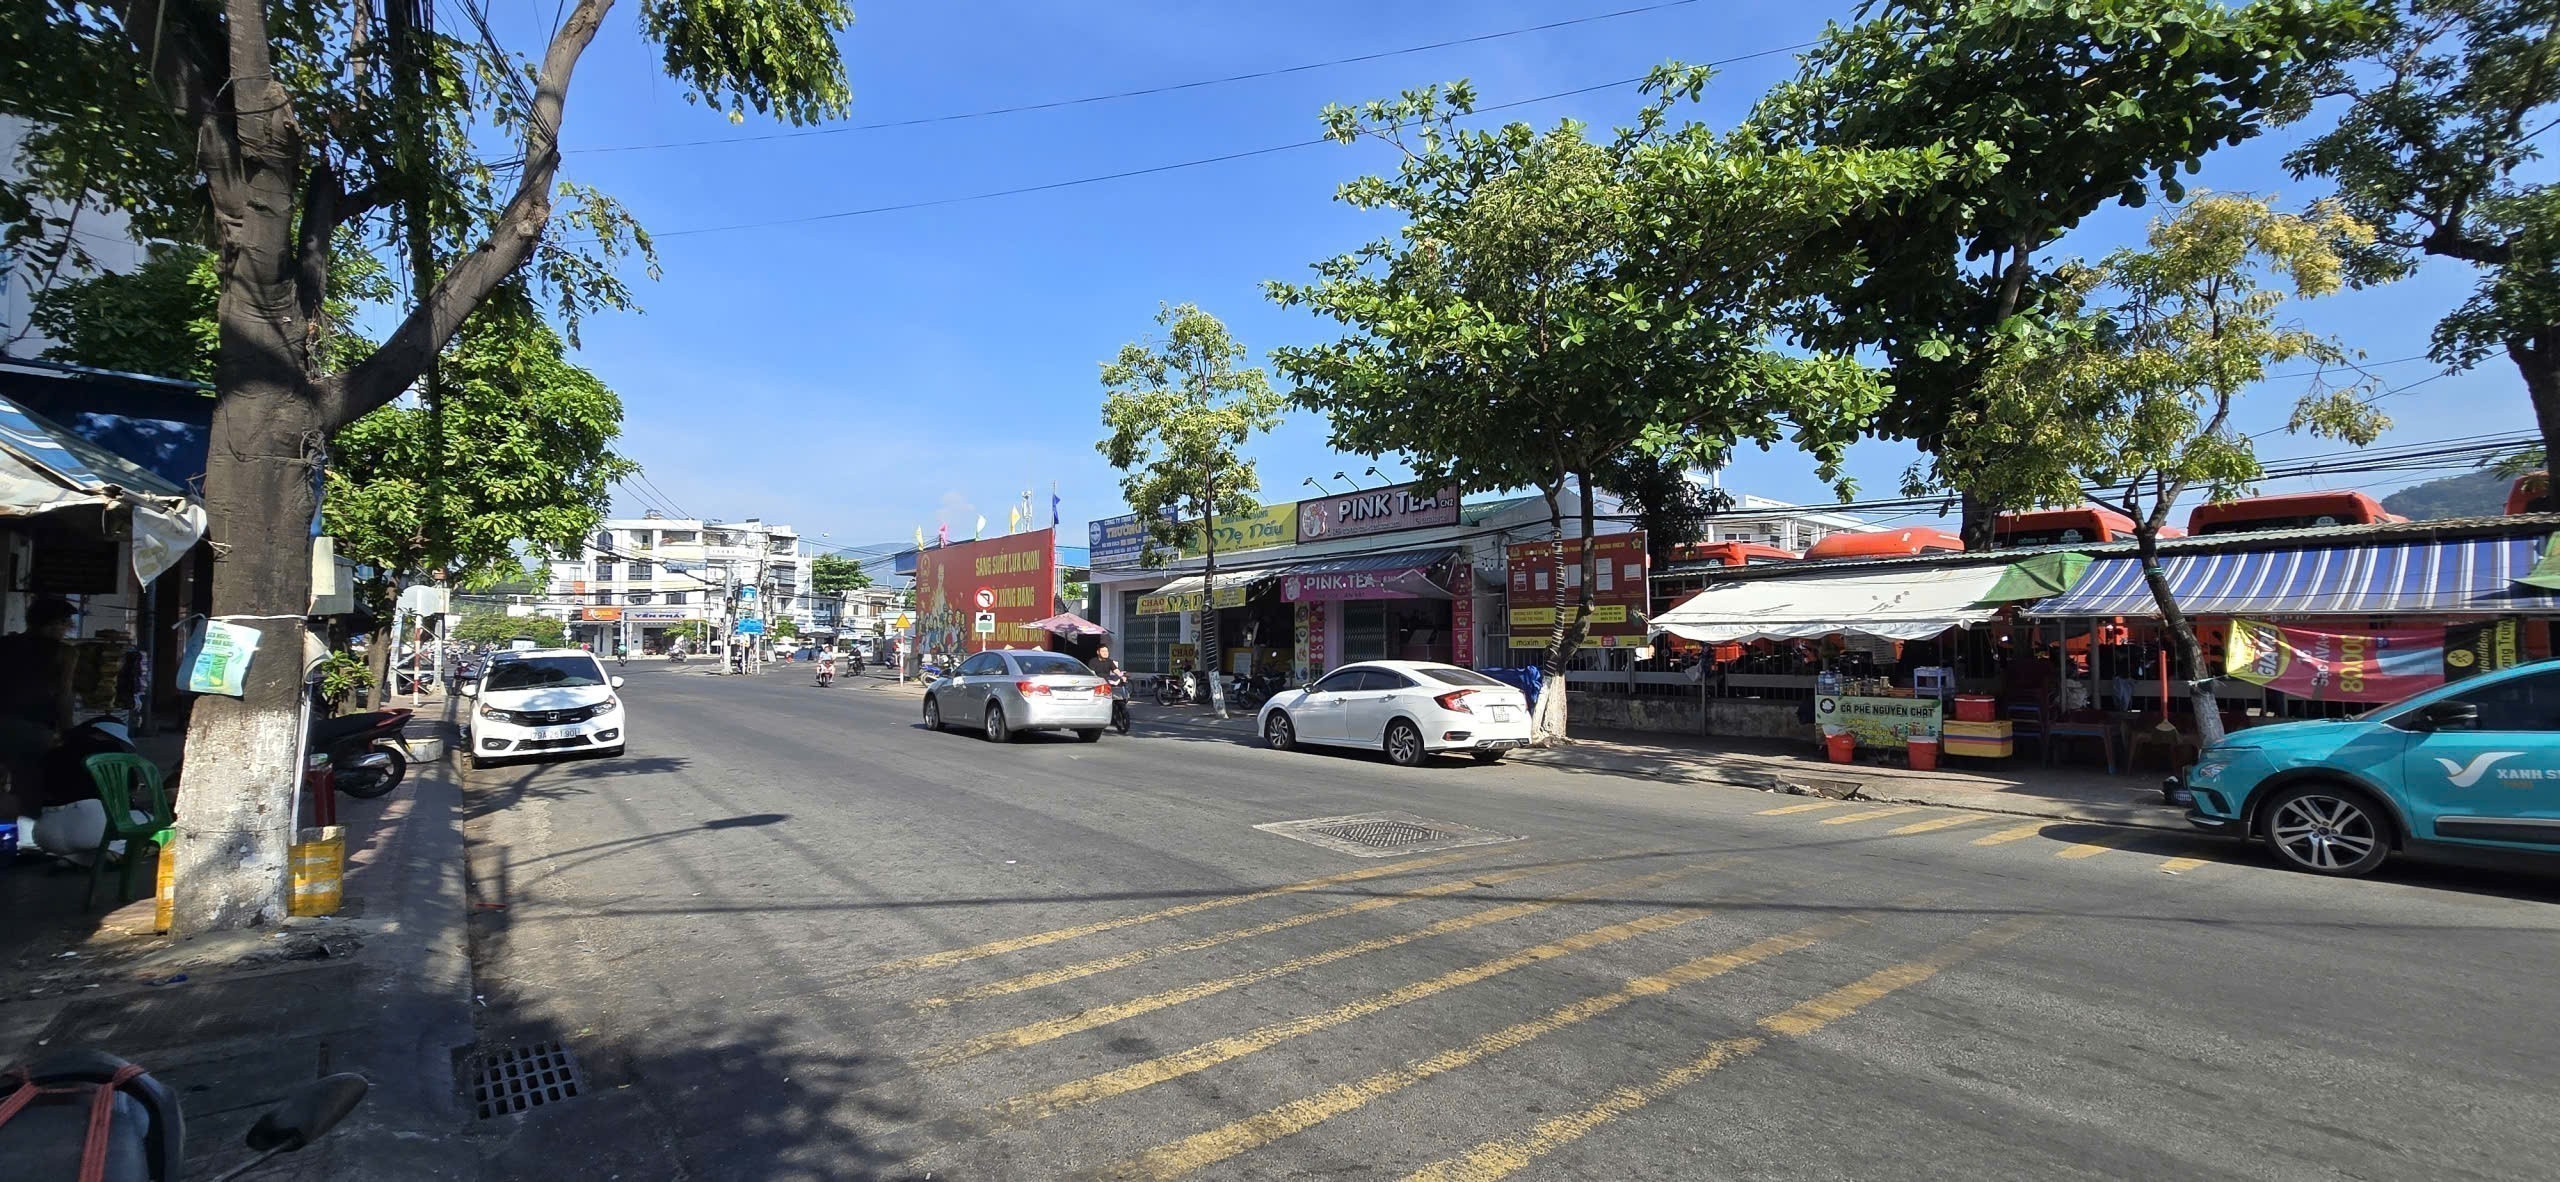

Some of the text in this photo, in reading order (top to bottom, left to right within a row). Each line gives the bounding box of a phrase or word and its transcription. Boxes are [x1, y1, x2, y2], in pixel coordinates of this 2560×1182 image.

[1338, 492, 1392, 523] PINK
[976, 554, 991, 576] SÁNG
[992, 548, 1008, 574] SUỐT
[1023, 550, 1040, 574] CHỌN
[1306, 576, 1343, 591] PINK
[1348, 573, 1375, 588] TEA
[2496, 769, 2560, 780] XANH S
